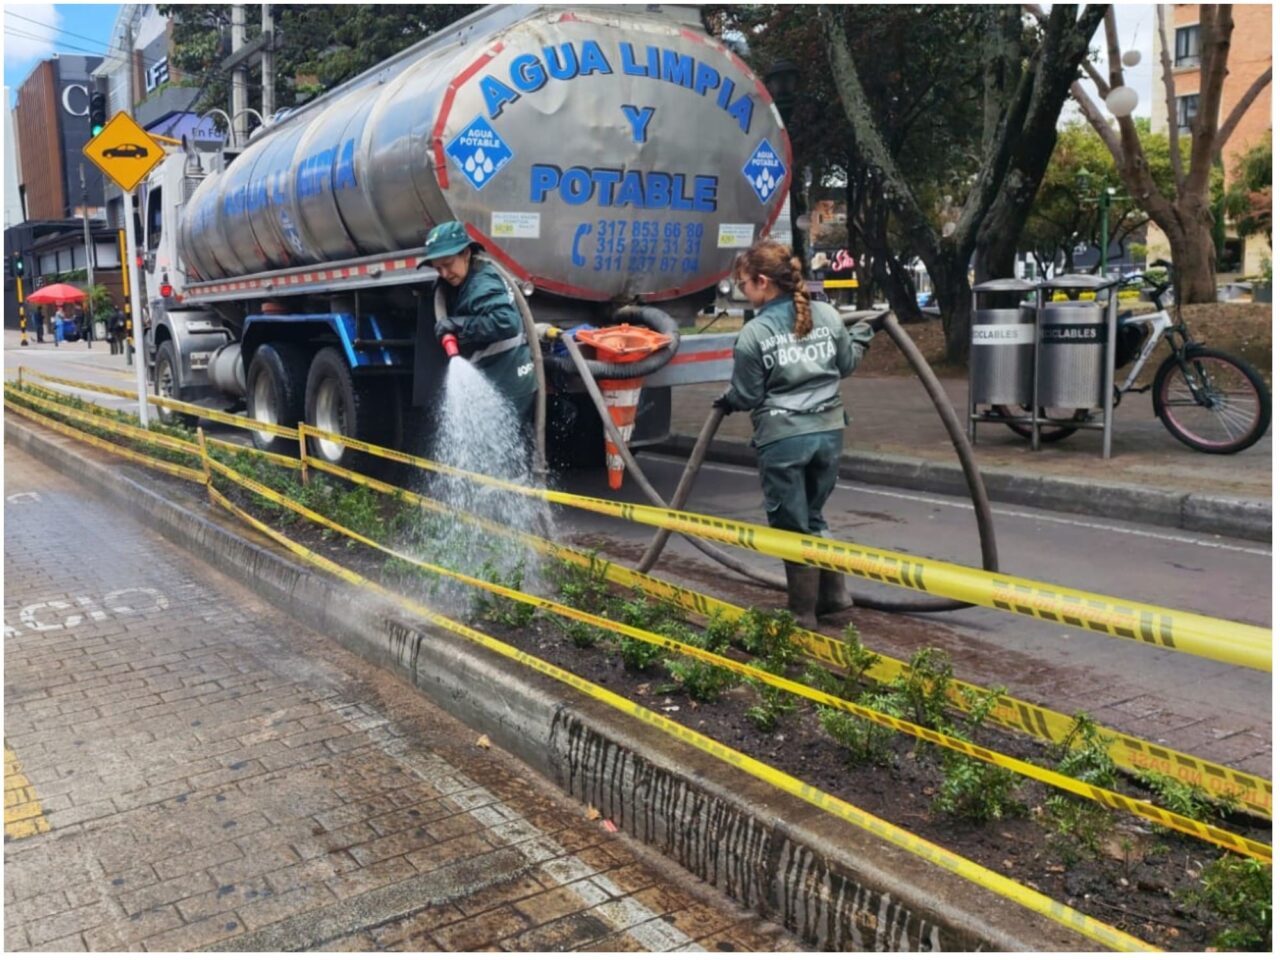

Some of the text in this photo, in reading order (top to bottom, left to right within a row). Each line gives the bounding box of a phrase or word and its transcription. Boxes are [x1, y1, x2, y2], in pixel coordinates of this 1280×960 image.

[478, 40, 755, 135] AGUA LIMPIA
[467, 128, 494, 139] AGUA
[621, 104, 656, 145] Y
[459, 136, 501, 149] POTABLE
[528, 163, 719, 213] POTABLE
[597, 220, 627, 237] 317
[631, 221, 659, 238] 853
[664, 222, 682, 239] 66
[595, 237, 625, 254] 315
[593, 255, 623, 272] 311
[5, 587, 169, 637] CIO
